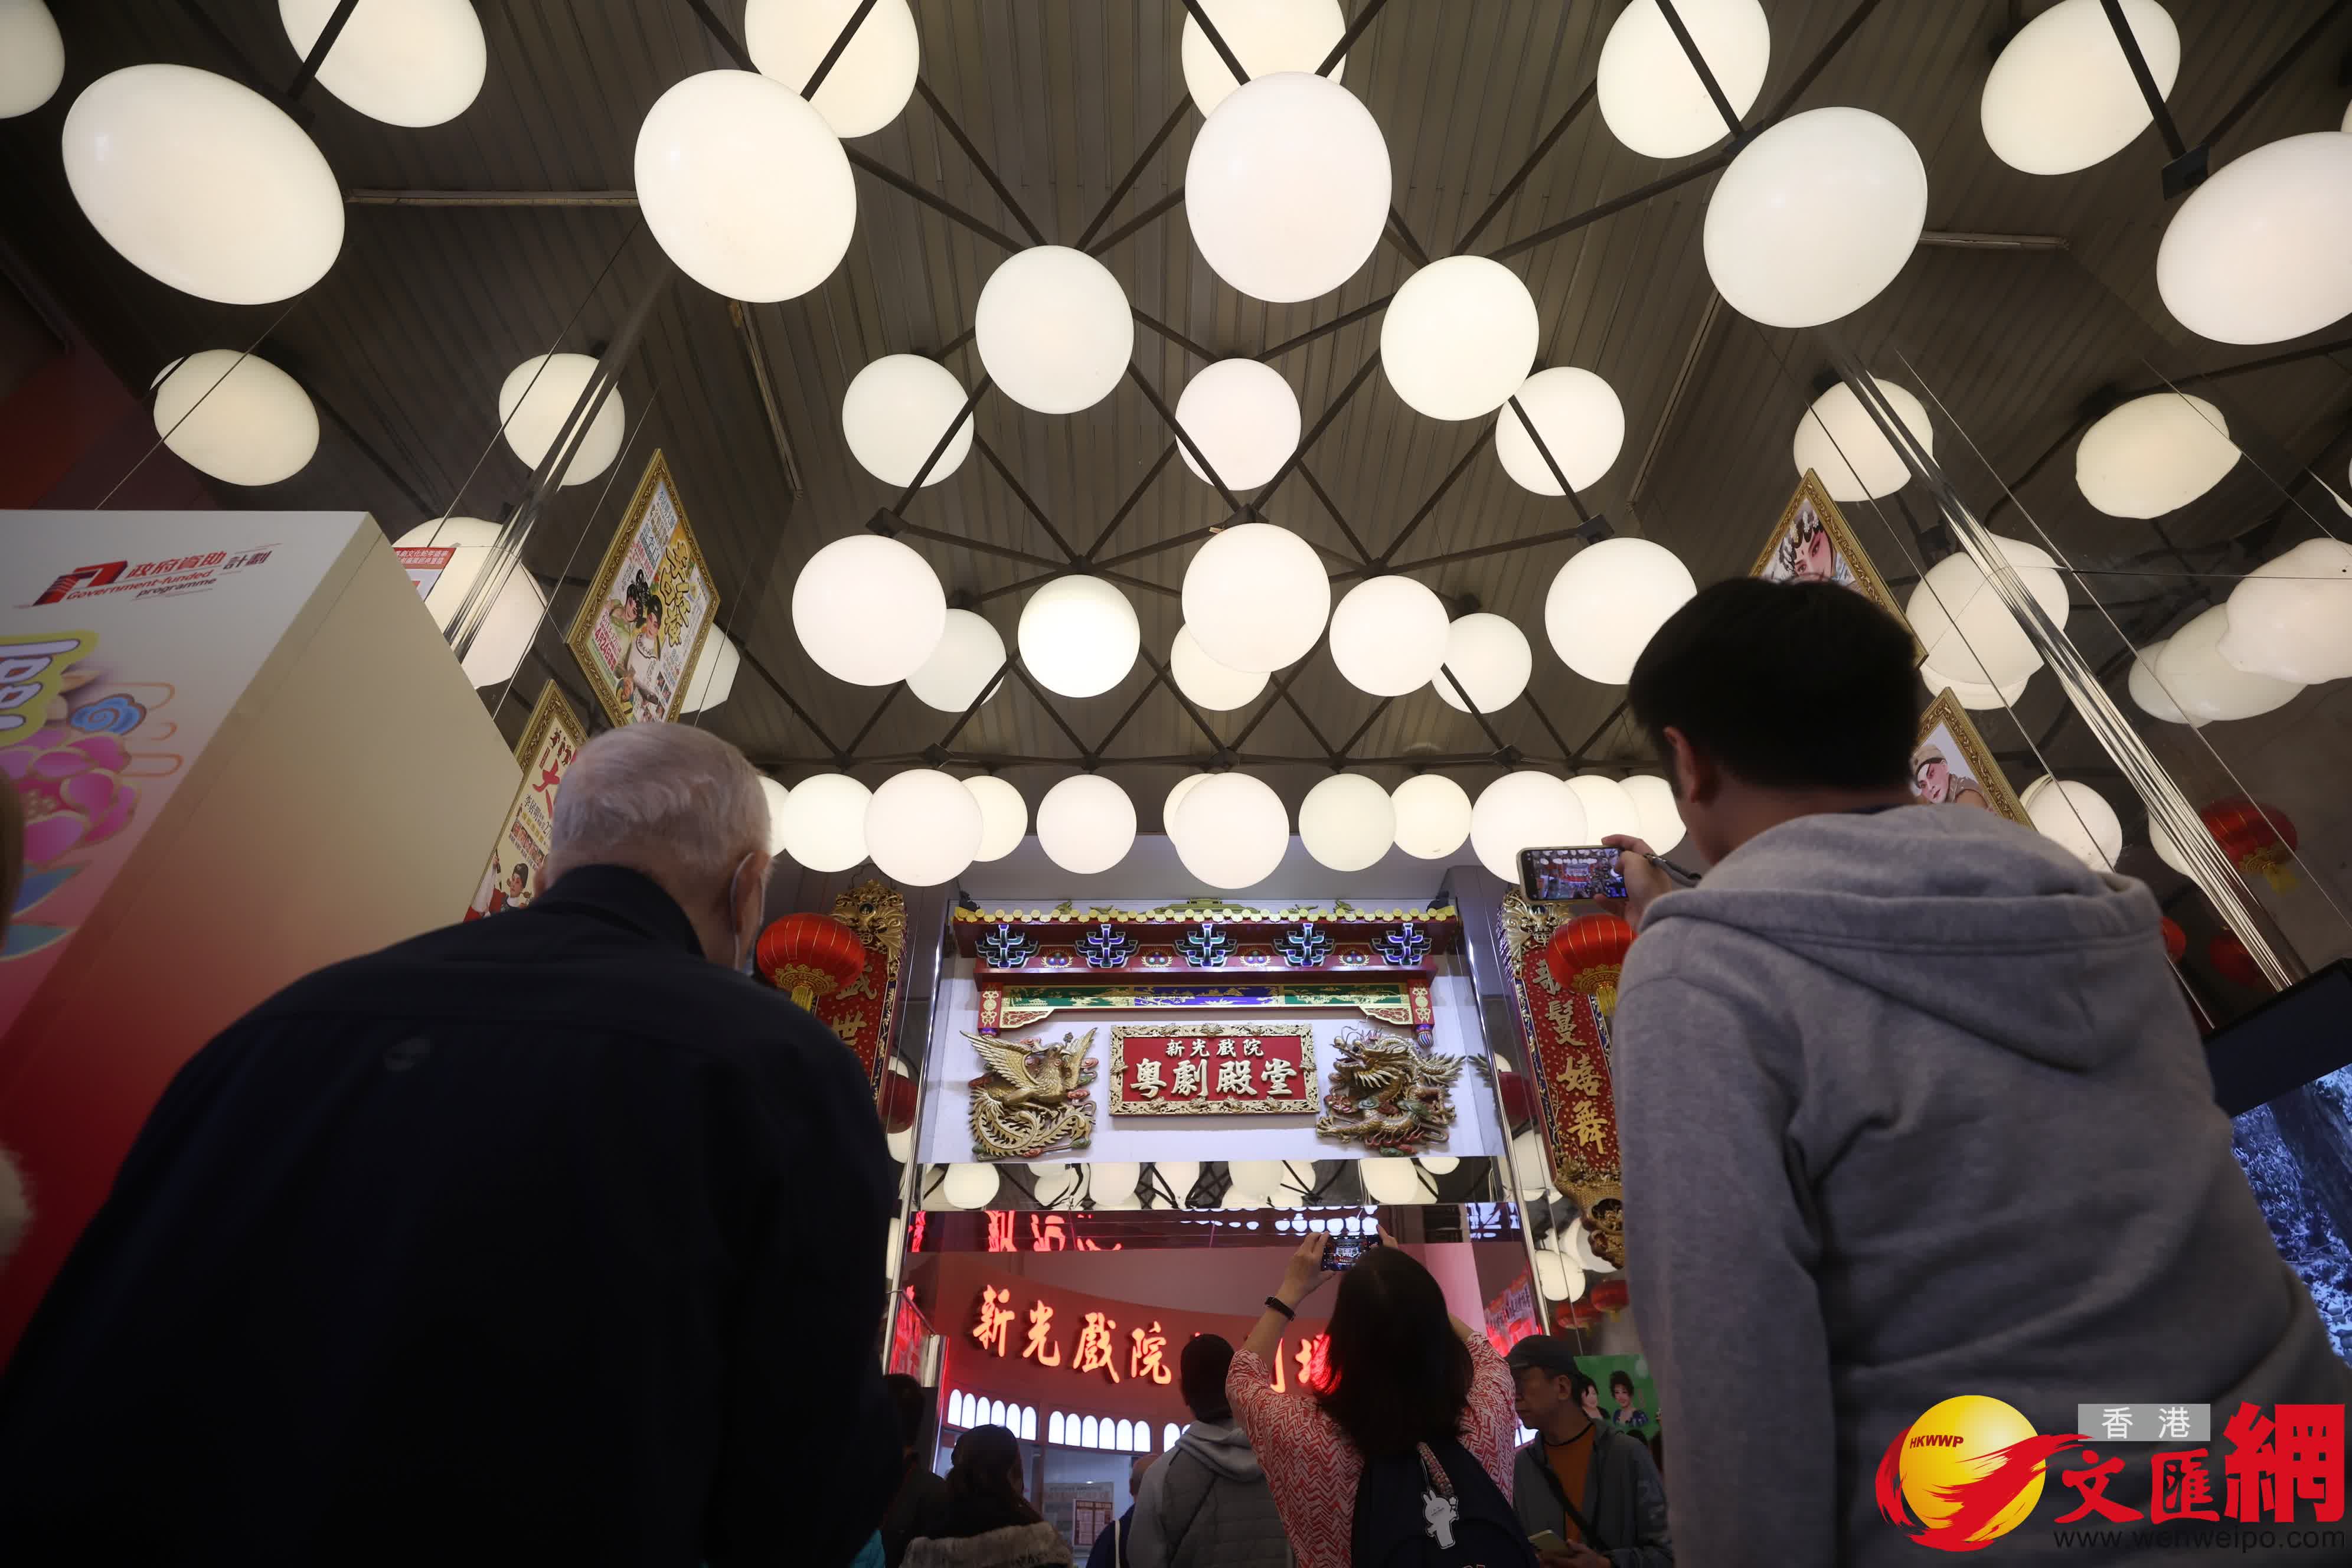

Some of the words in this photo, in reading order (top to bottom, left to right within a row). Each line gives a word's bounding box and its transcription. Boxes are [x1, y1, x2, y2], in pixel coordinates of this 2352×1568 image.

[125, 551, 227, 579] 政府資助
[223, 550, 272, 570] 計劃
[66, 569, 215, 599] Government-funded
[136, 578, 217, 598] programme
[1165, 1038, 1264, 1058] 新光戲院
[1130, 1058, 1297, 1098] 粵劇殿堂
[972, 1284, 1172, 1384] 新光戲院
